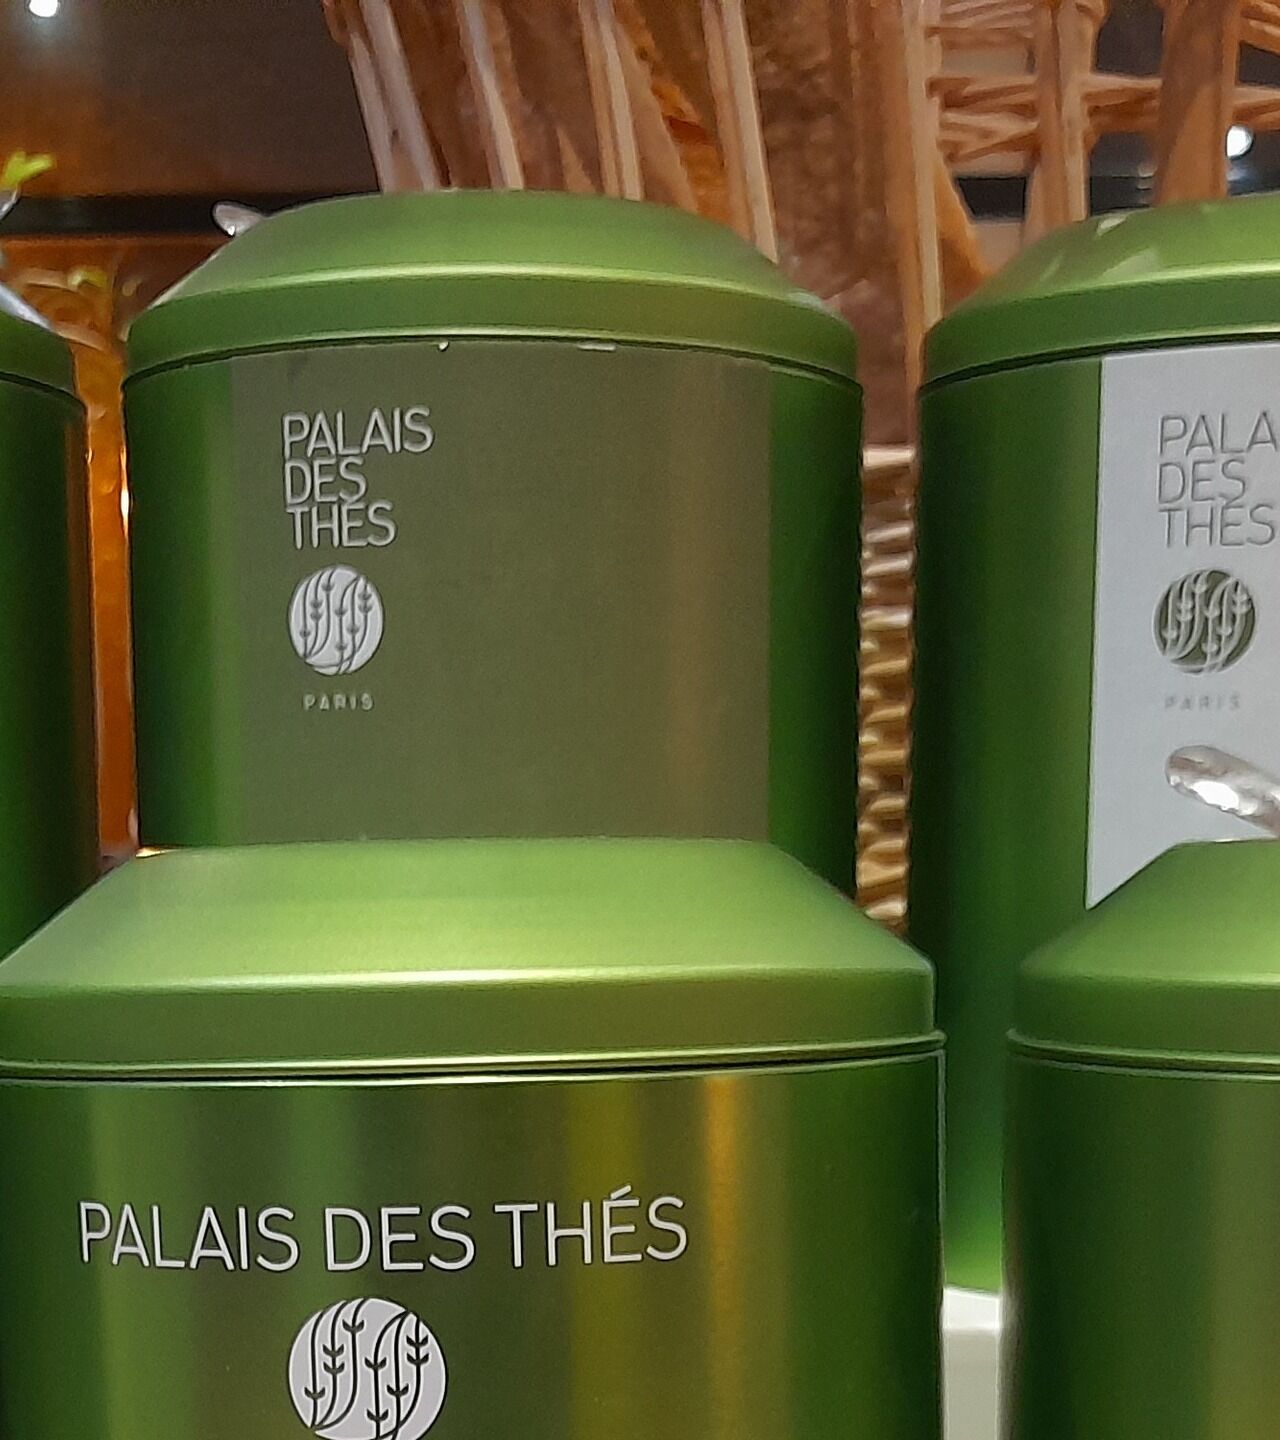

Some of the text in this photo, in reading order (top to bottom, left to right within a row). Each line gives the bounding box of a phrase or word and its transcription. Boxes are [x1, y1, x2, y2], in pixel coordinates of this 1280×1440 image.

[282, 407, 435, 458] PALAIS
[283, 457, 367, 503] DES
[1157, 458, 1247, 504] DES
[303, 693, 374, 711] PARIS
[78, 1184, 688, 1273] PALAIS DES THÉS
